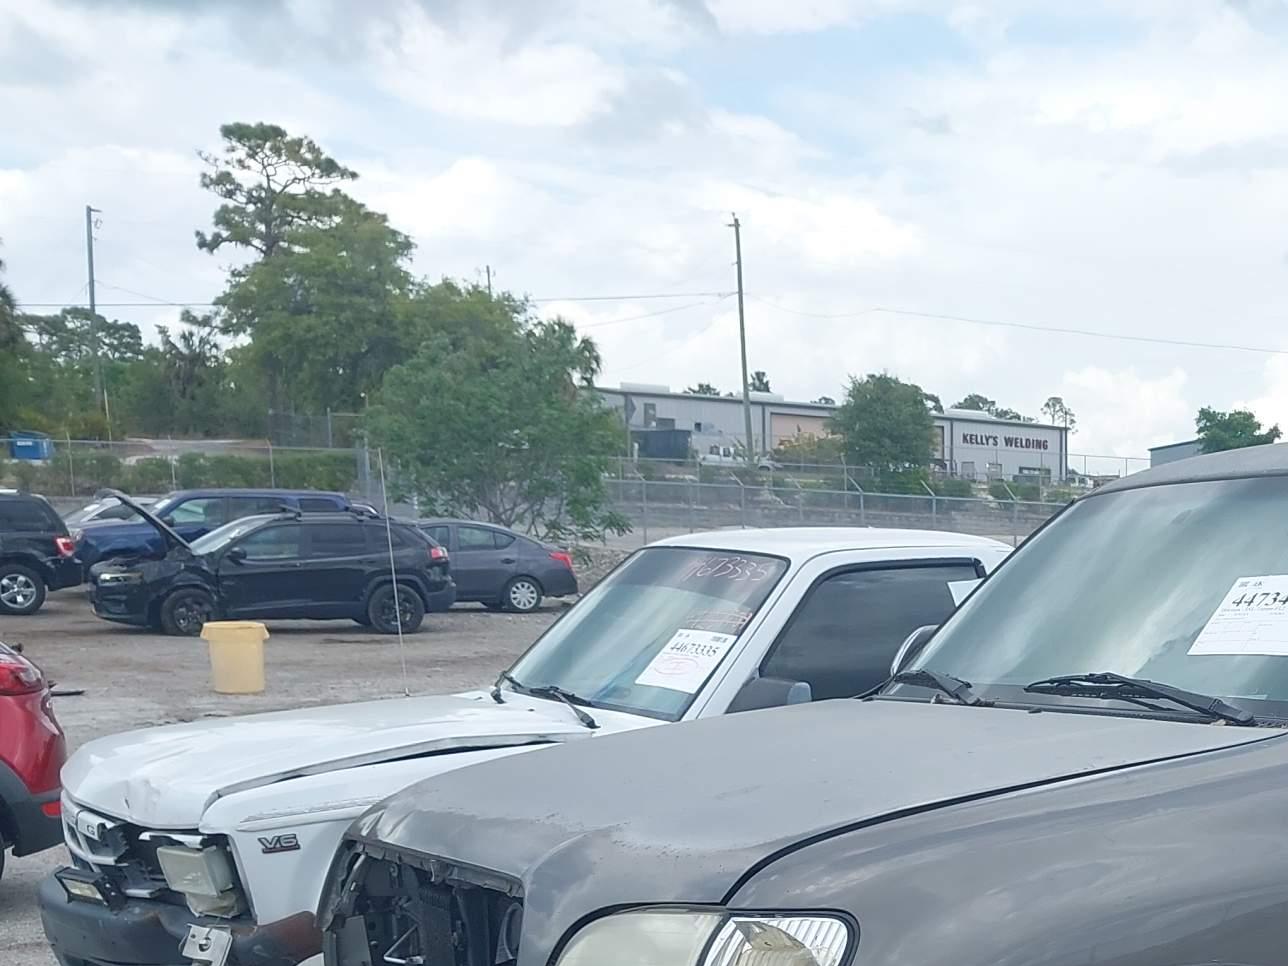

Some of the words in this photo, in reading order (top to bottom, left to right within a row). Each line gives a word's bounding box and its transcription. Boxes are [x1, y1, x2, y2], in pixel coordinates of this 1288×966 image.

[962, 433, 999, 446] KELLY'S
[1004, 436, 1048, 450] WELDING
[670, 642, 720, 657] 44673335
[86, 824, 96, 836] G
[257, 833, 299, 850] V6
